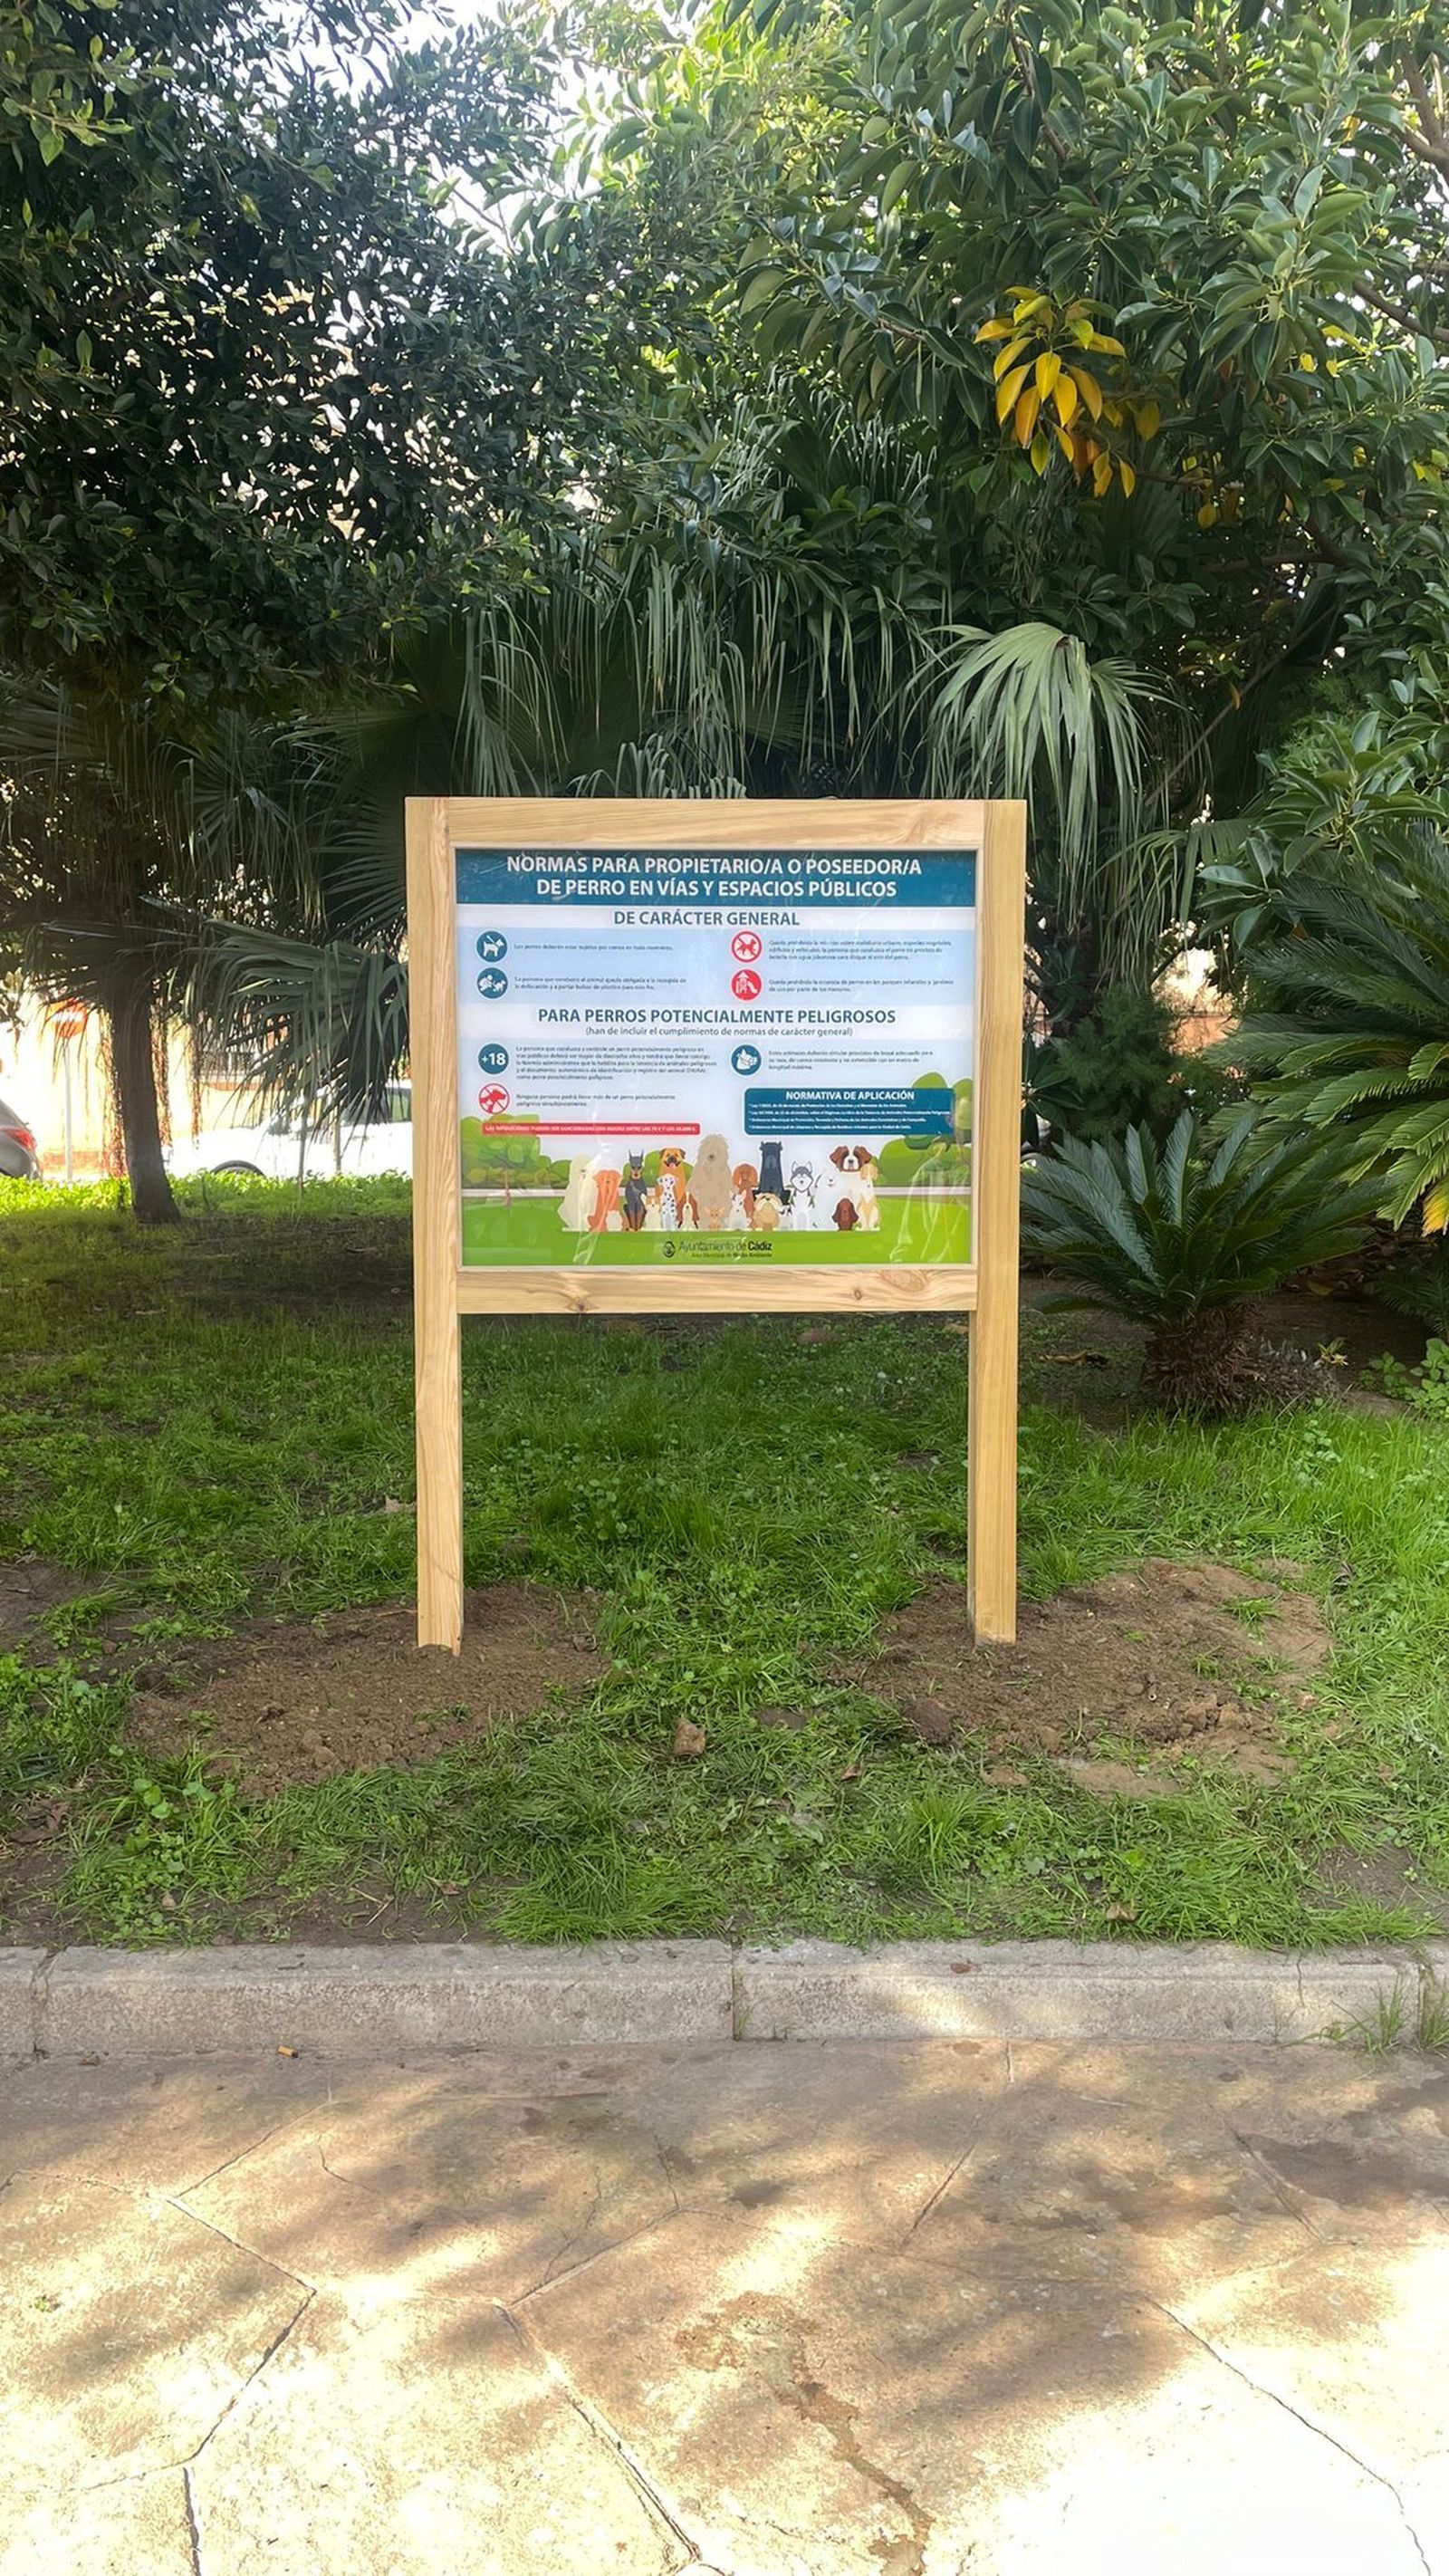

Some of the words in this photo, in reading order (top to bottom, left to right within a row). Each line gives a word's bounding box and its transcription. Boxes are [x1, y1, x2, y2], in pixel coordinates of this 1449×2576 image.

[507, 856, 588, 873] NORMAS
[592, 857, 641, 873] PARA
[645, 858, 783, 875] PROPIETARIO/A
[787, 858, 801, 874] O
[806, 858, 922, 875] POSEEDOR/A
[537, 879, 561, 895] DE
[565, 879, 626, 896] PERRO
[629, 879, 653, 896] EN
[657, 877, 699, 896] VÍAS
[702, 880, 715, 896] Y
[718, 880, 804, 897] ESPACIOS
[809, 878, 897, 897] PÚBLICOS
[614, 911, 636, 925] DE
[638, 908, 723, 926] CARÁCTER
[726, 911, 801, 926] GENERAL
[539, 1008, 581, 1023] PARA
[585, 1008, 647, 1023] PERROS
[650, 1009, 793, 1024] POTENCIALMENTE
[798, 1009, 896, 1024] PELIGROSOS
[585, 1026, 606, 1037] (han
[607, 1026, 619, 1035] de
[620, 1026, 648, 1035] incluir
[648, 1026, 657, 1035] el
[658, 1026, 719, 1038] cumplimiento
[721, 1027, 732, 1036] de
[734, 1028, 766, 1036] normas
[767, 1027, 780, 1036] de
[781, 1027, 816, 1036] carácter
[817, 1027, 853, 1039] general)
[482, 1053, 506, 1066] +18
[785, 1091, 842, 1101] NORMATIVA
[843, 1091, 857, 1101] DE
[858, 1089, 915, 1101] APLICACIÓN
[747, 1241, 772, 1251] Cádiz
